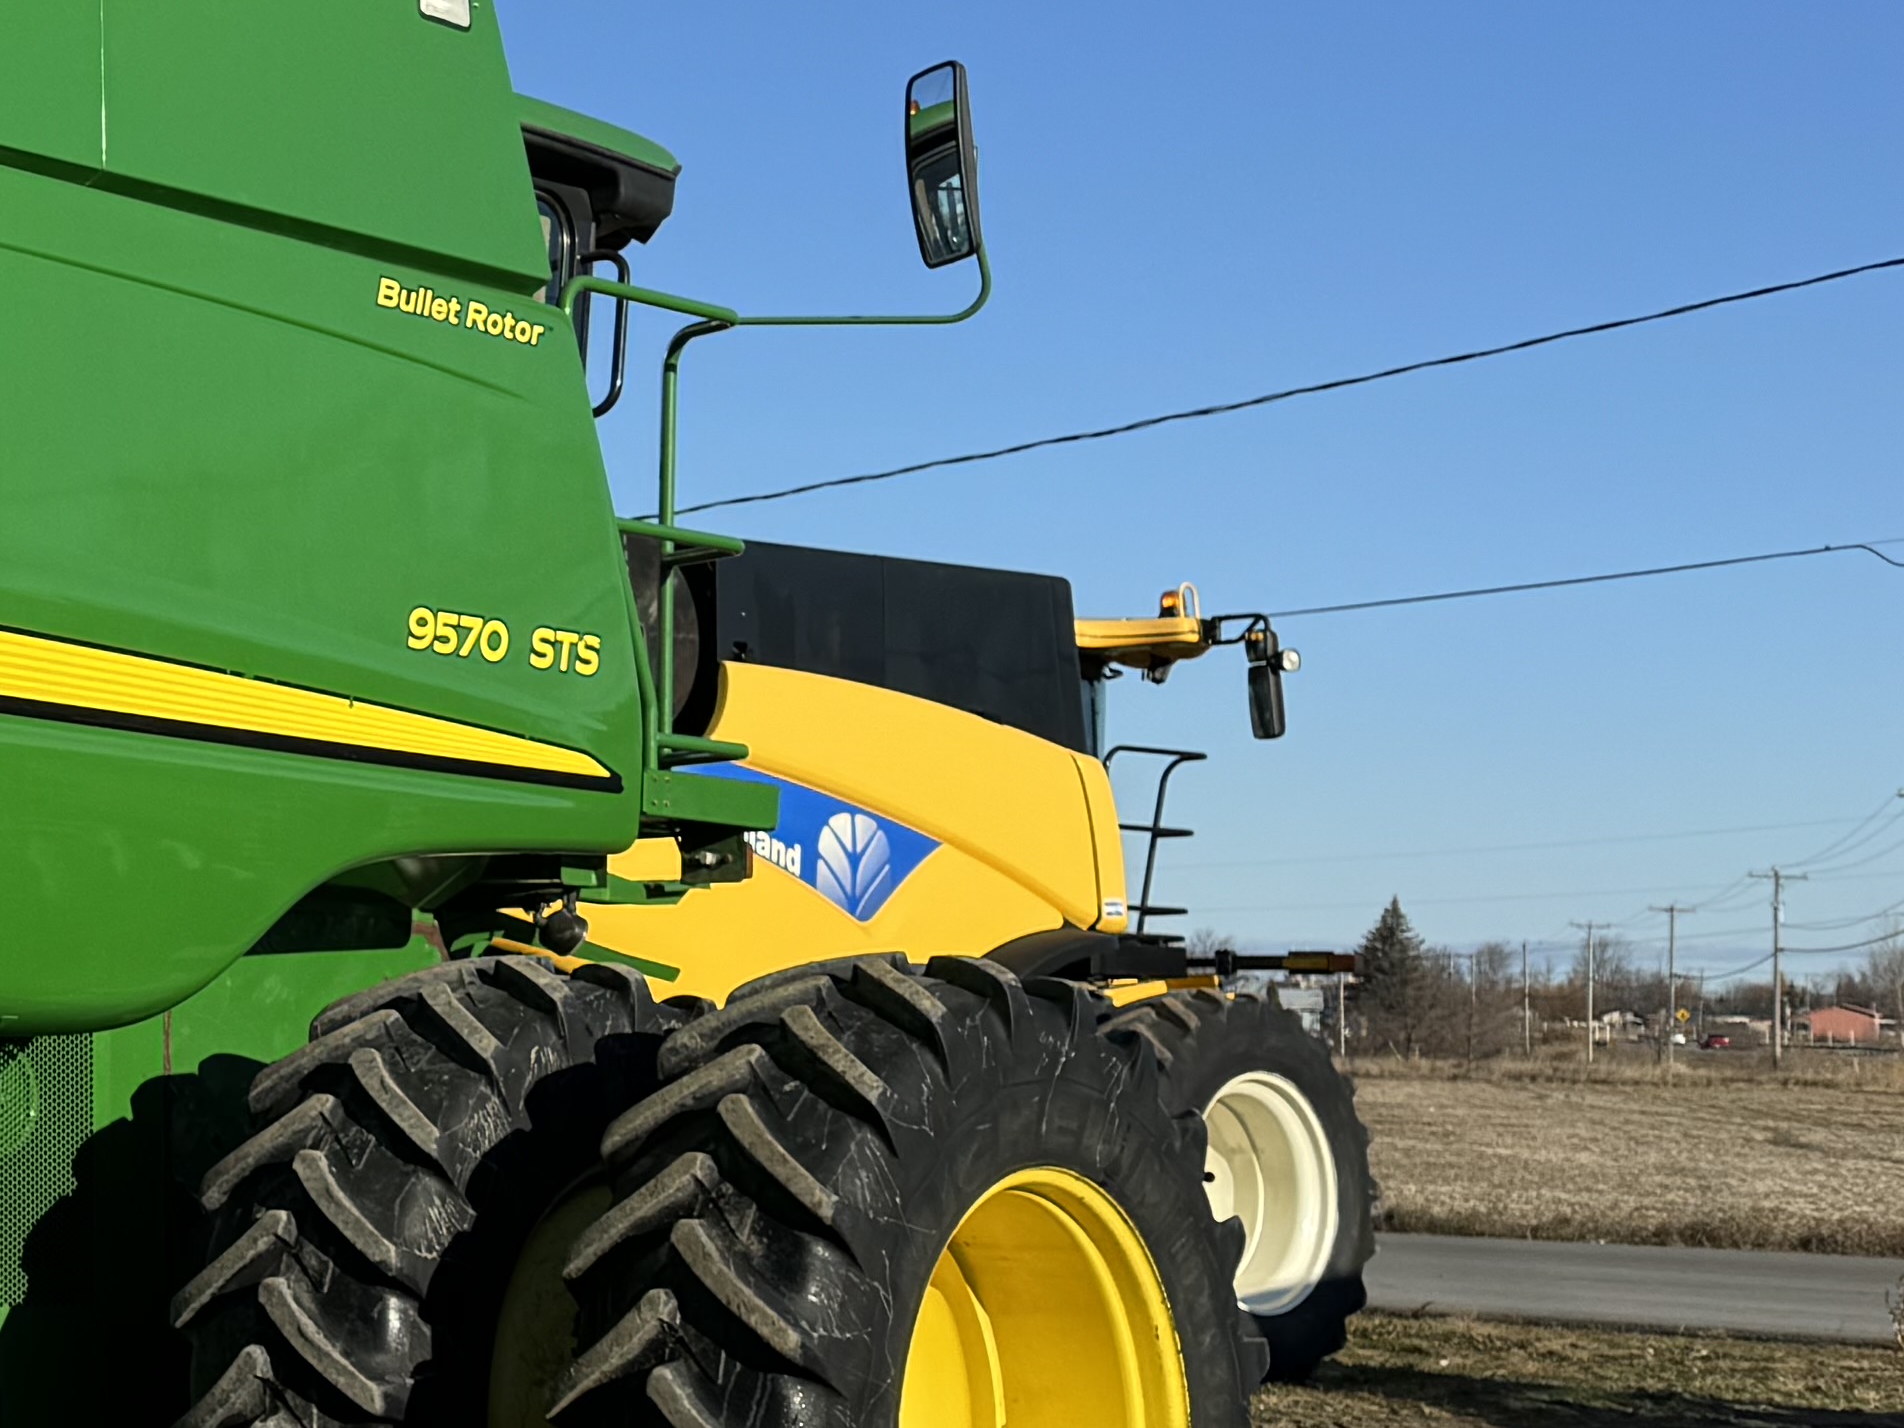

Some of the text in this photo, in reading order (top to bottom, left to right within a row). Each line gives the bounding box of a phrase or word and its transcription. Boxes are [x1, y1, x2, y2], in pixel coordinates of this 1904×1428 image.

[376, 275, 545, 346] Bullet Rotor
[407, 606, 602, 676] 9570 STS
